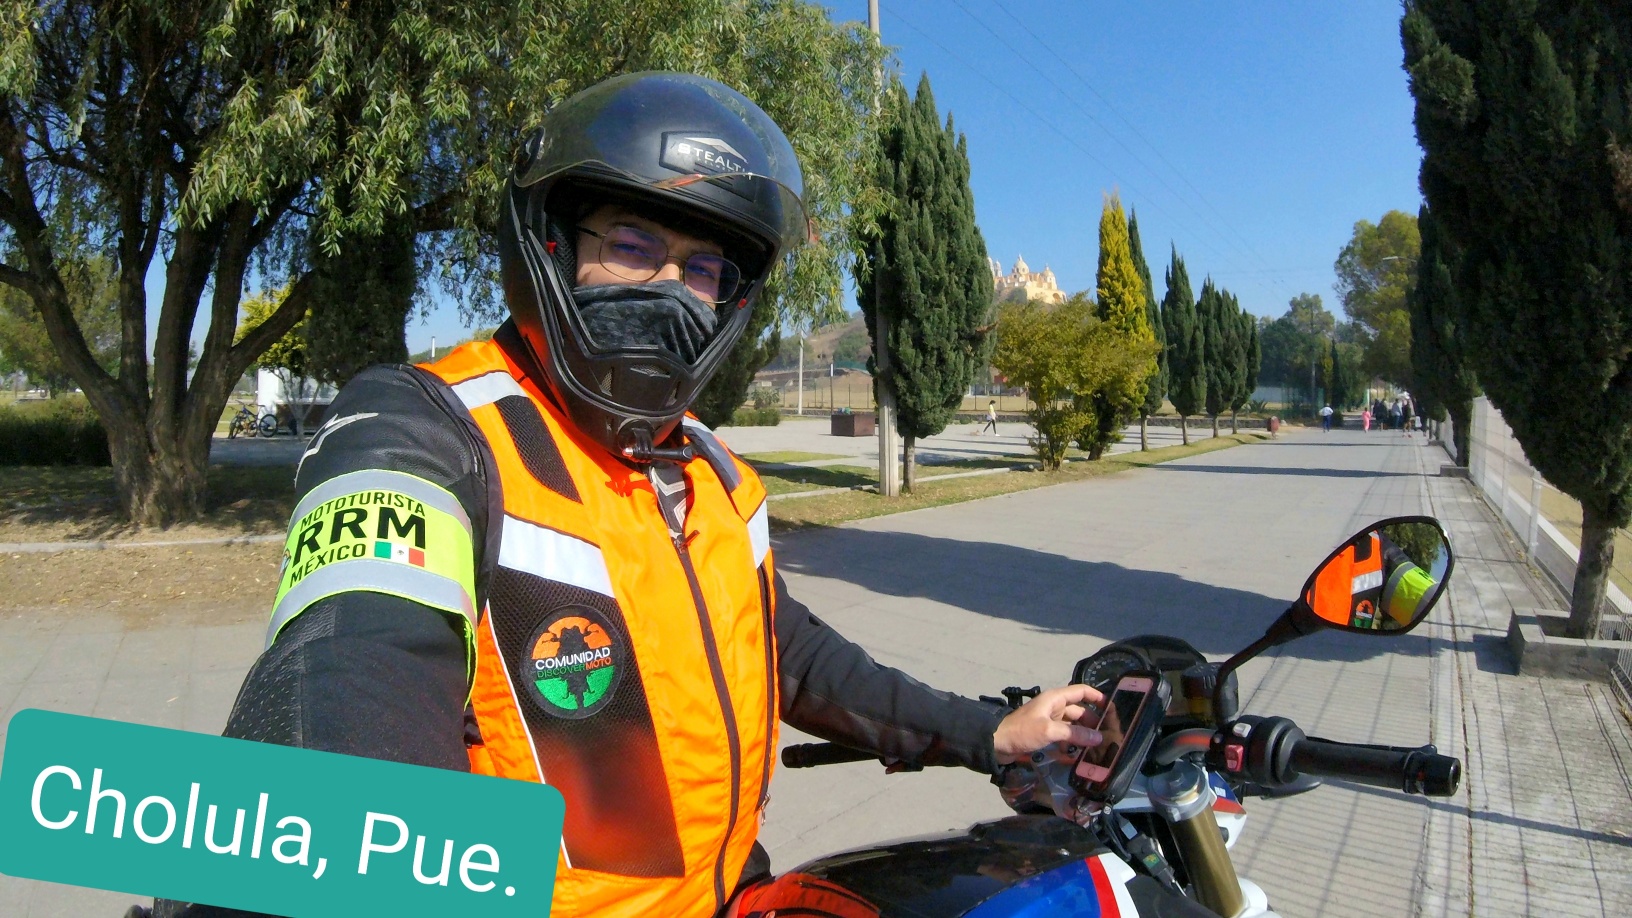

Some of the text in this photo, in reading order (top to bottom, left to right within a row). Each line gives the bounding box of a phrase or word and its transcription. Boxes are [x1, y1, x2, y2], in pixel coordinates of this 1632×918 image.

[299, 491, 426, 532] MOTOTURISTA
[291, 506, 426, 569] RRM
[289, 543, 367, 588] MÉXICO
[535, 646, 611, 670] COMUNIDAD
